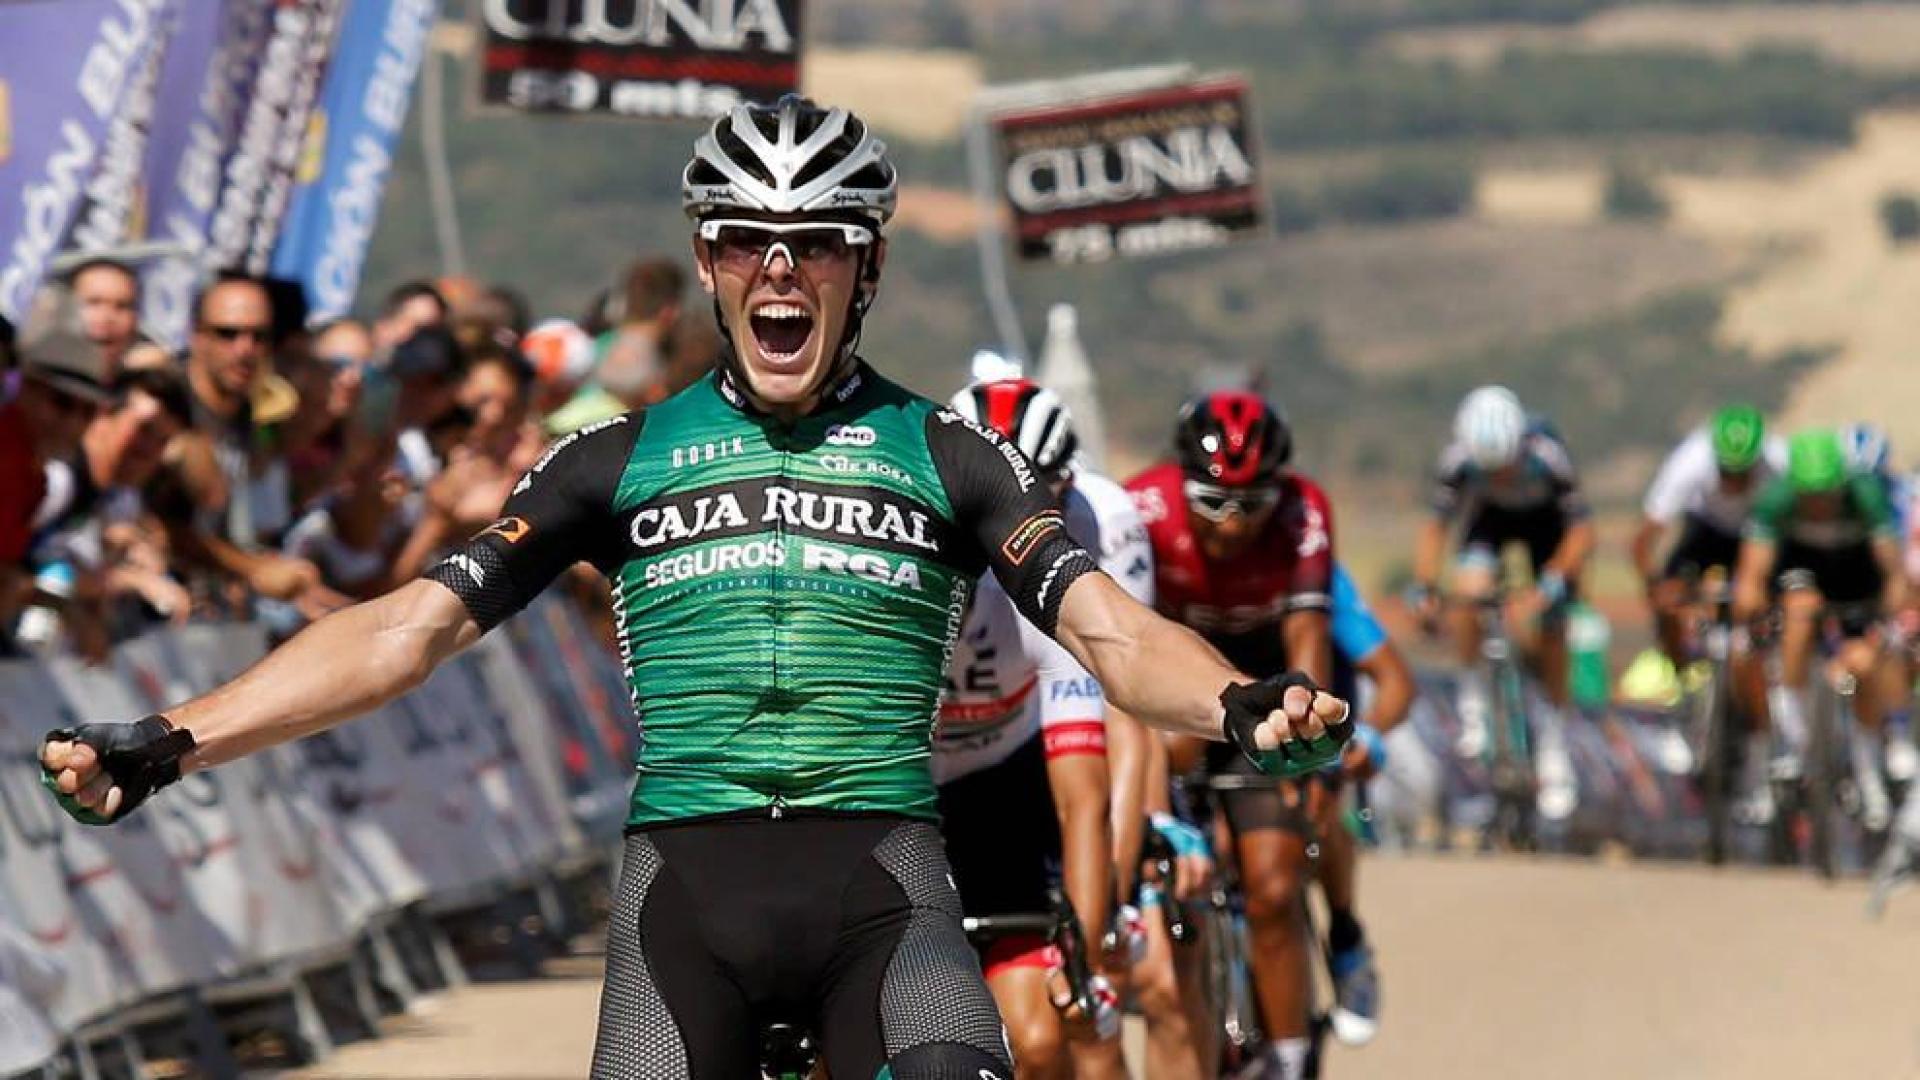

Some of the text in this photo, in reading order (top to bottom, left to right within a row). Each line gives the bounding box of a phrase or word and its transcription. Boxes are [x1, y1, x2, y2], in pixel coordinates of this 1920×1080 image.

[630, 491, 749, 548] CAJA
[762, 485, 940, 552] RURAL
[644, 539, 785, 590] SEGUROS
[802, 544, 923, 592] RGA
